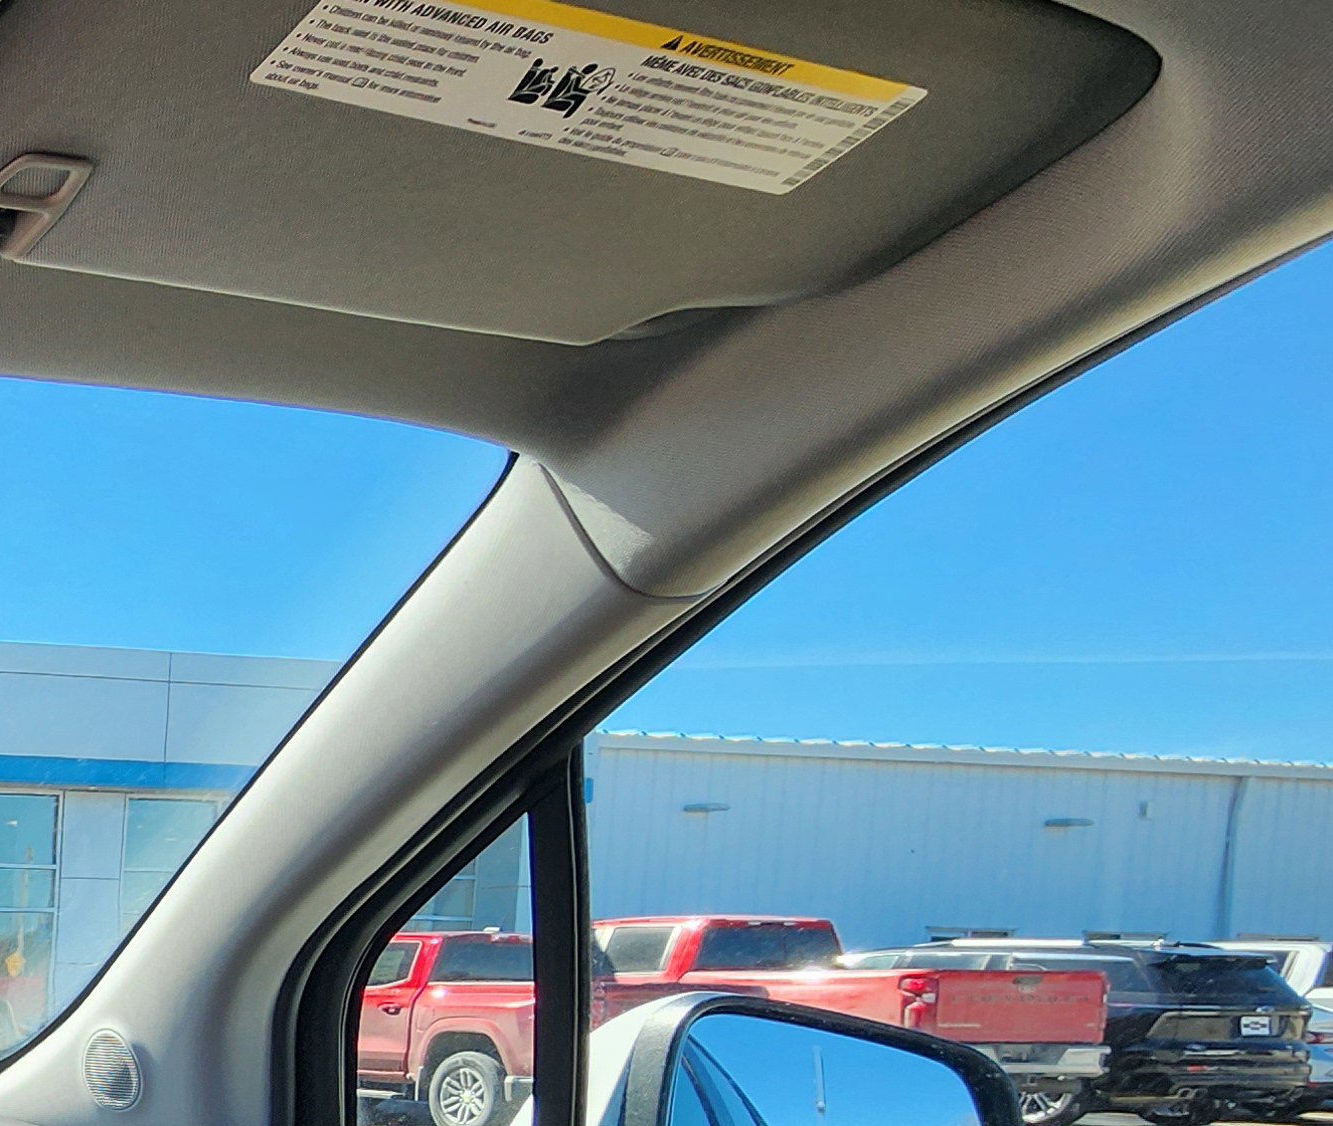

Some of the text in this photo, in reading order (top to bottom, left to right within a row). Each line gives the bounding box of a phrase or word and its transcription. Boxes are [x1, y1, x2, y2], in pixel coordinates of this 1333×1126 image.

[410, 3, 487, 30] ADVANCED
[485, 21, 514, 35] AIR
[512, 26, 554, 44] BAGS
[680, 41, 795, 77] AVERTISSEMENT
